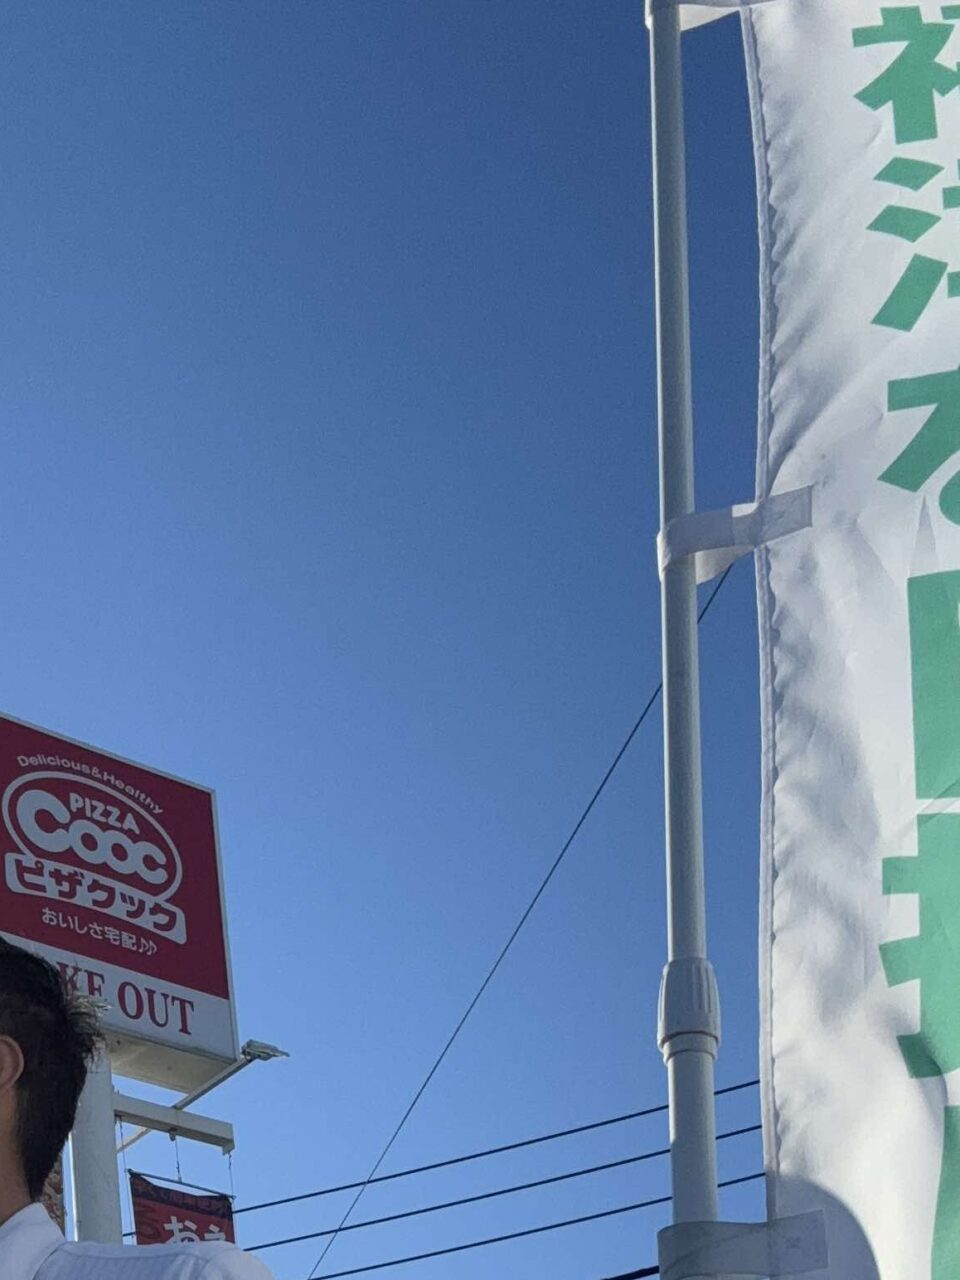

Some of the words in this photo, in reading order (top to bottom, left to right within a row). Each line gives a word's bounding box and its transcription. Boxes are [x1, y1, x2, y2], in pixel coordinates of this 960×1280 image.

[69, 791, 140, 835] PIZZA
[14, 857, 178, 932] ピザクック
[56, 961, 106, 1001] KE
[117, 981, 195, 1036] OUT
